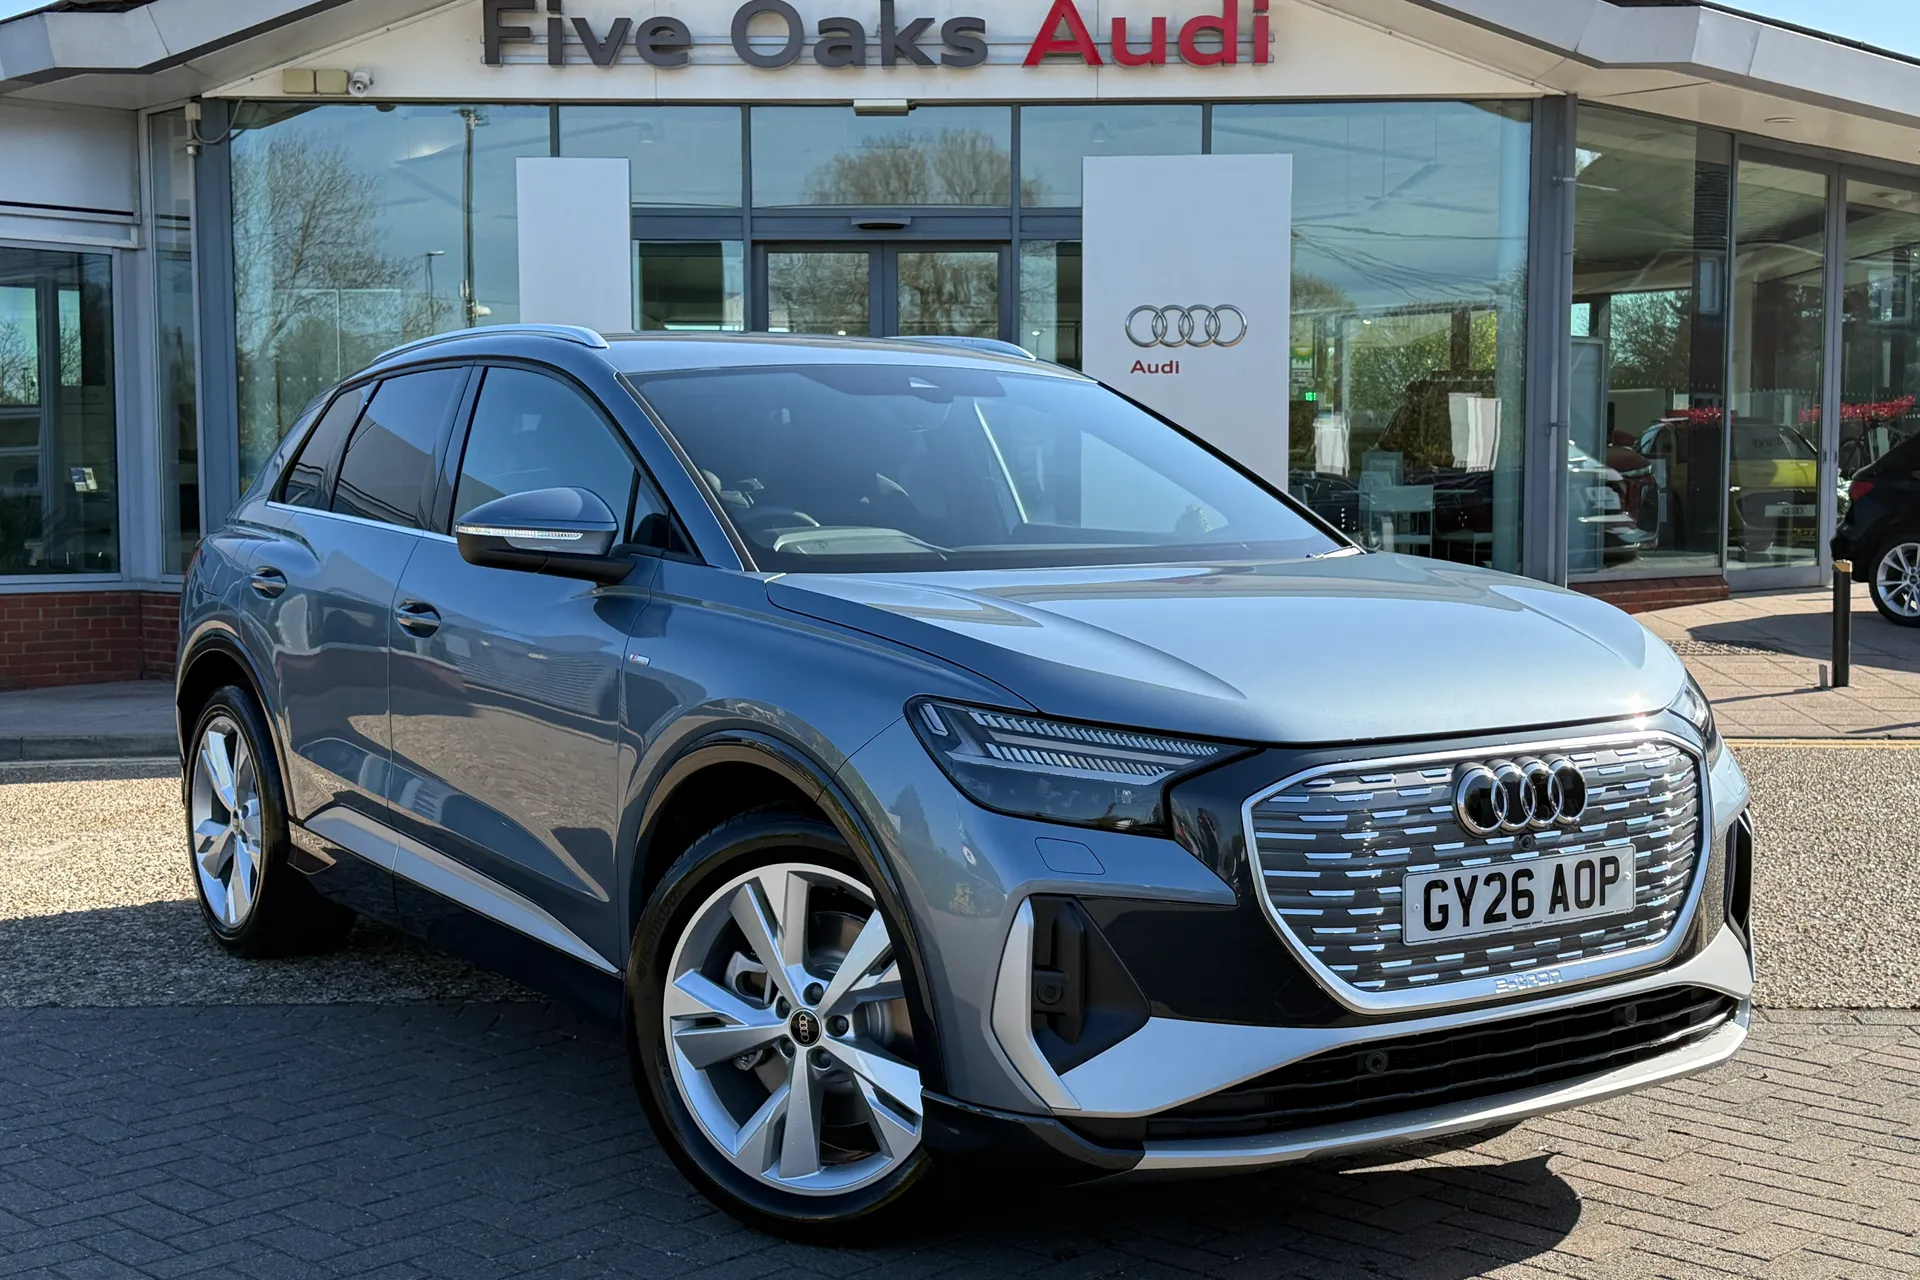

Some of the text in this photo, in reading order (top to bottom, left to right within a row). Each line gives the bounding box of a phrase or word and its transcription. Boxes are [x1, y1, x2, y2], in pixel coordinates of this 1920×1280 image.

[483, 0, 1270, 69] Five Oaks Audi
[1130, 360, 1180, 374] Audi
[1423, 855, 1620, 932] GY26 AOP
